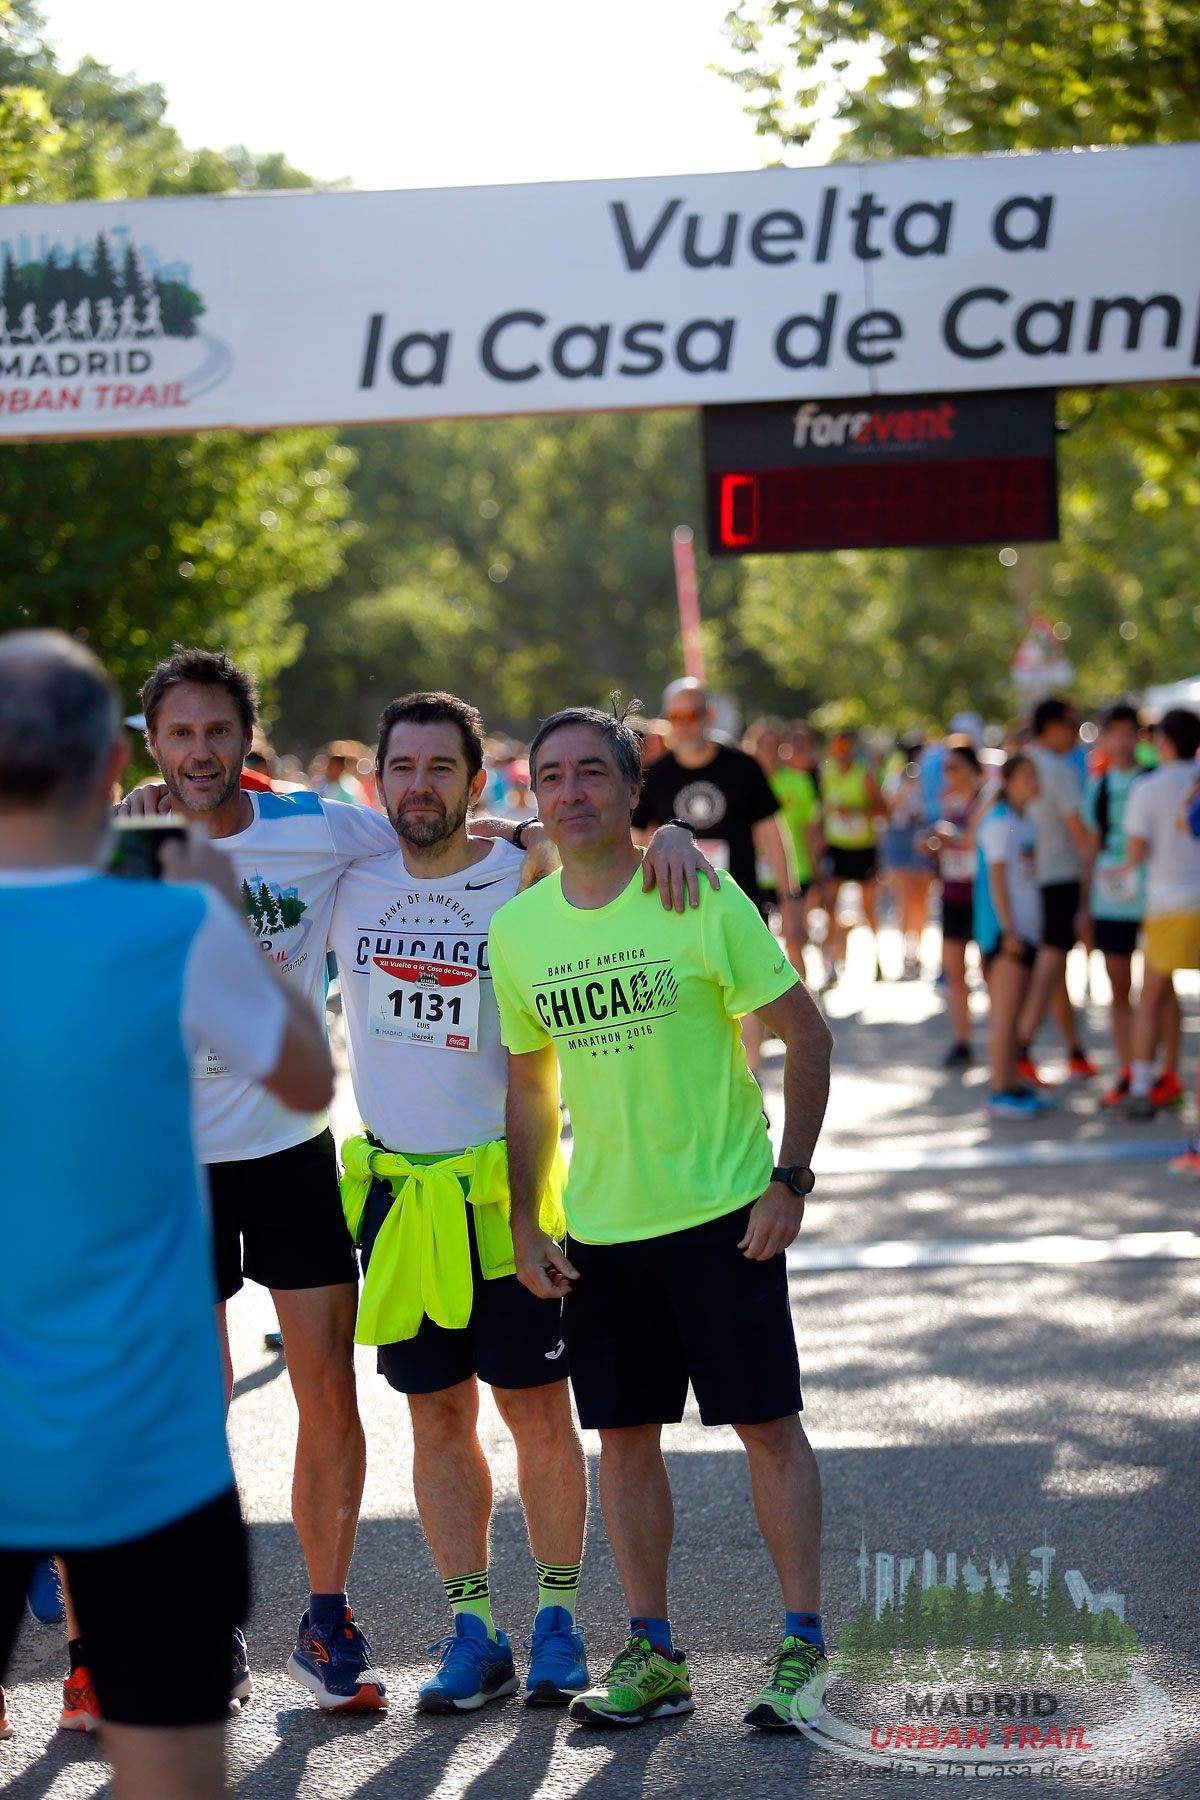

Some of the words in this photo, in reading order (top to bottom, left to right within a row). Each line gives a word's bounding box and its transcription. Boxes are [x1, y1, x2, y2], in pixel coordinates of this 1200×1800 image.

[609, 187, 955, 272] Vuelta
[992, 194, 1055, 250] a
[358, 312, 453, 389] la
[479, 309, 737, 382] Casa
[775, 293, 904, 369] de
[0, 350, 153, 378] MADRID
[0, 387, 82, 413] BAN
[95, 383, 190, 409] TRAIL
[379, 899, 403, 928] BANK
[407, 892, 421, 906] OF
[428, 892, 475, 929] AMERICA
[356, 935, 490, 972] CHICAGO
[390, 961, 412, 969] Vuelta
[452, 969, 473, 978] Campo
[547, 962, 573, 977] BANK
[578, 958, 590, 971] OF
[597, 948, 646, 967] AMERICA
[388, 989, 462, 1026] 1131
[535, 966, 680, 1028] CHICAGO
[417, 1022, 430, 1030] LUIS
[568, 1032, 621, 1050] MARATHON
[627, 1024, 653, 1040] 2016
